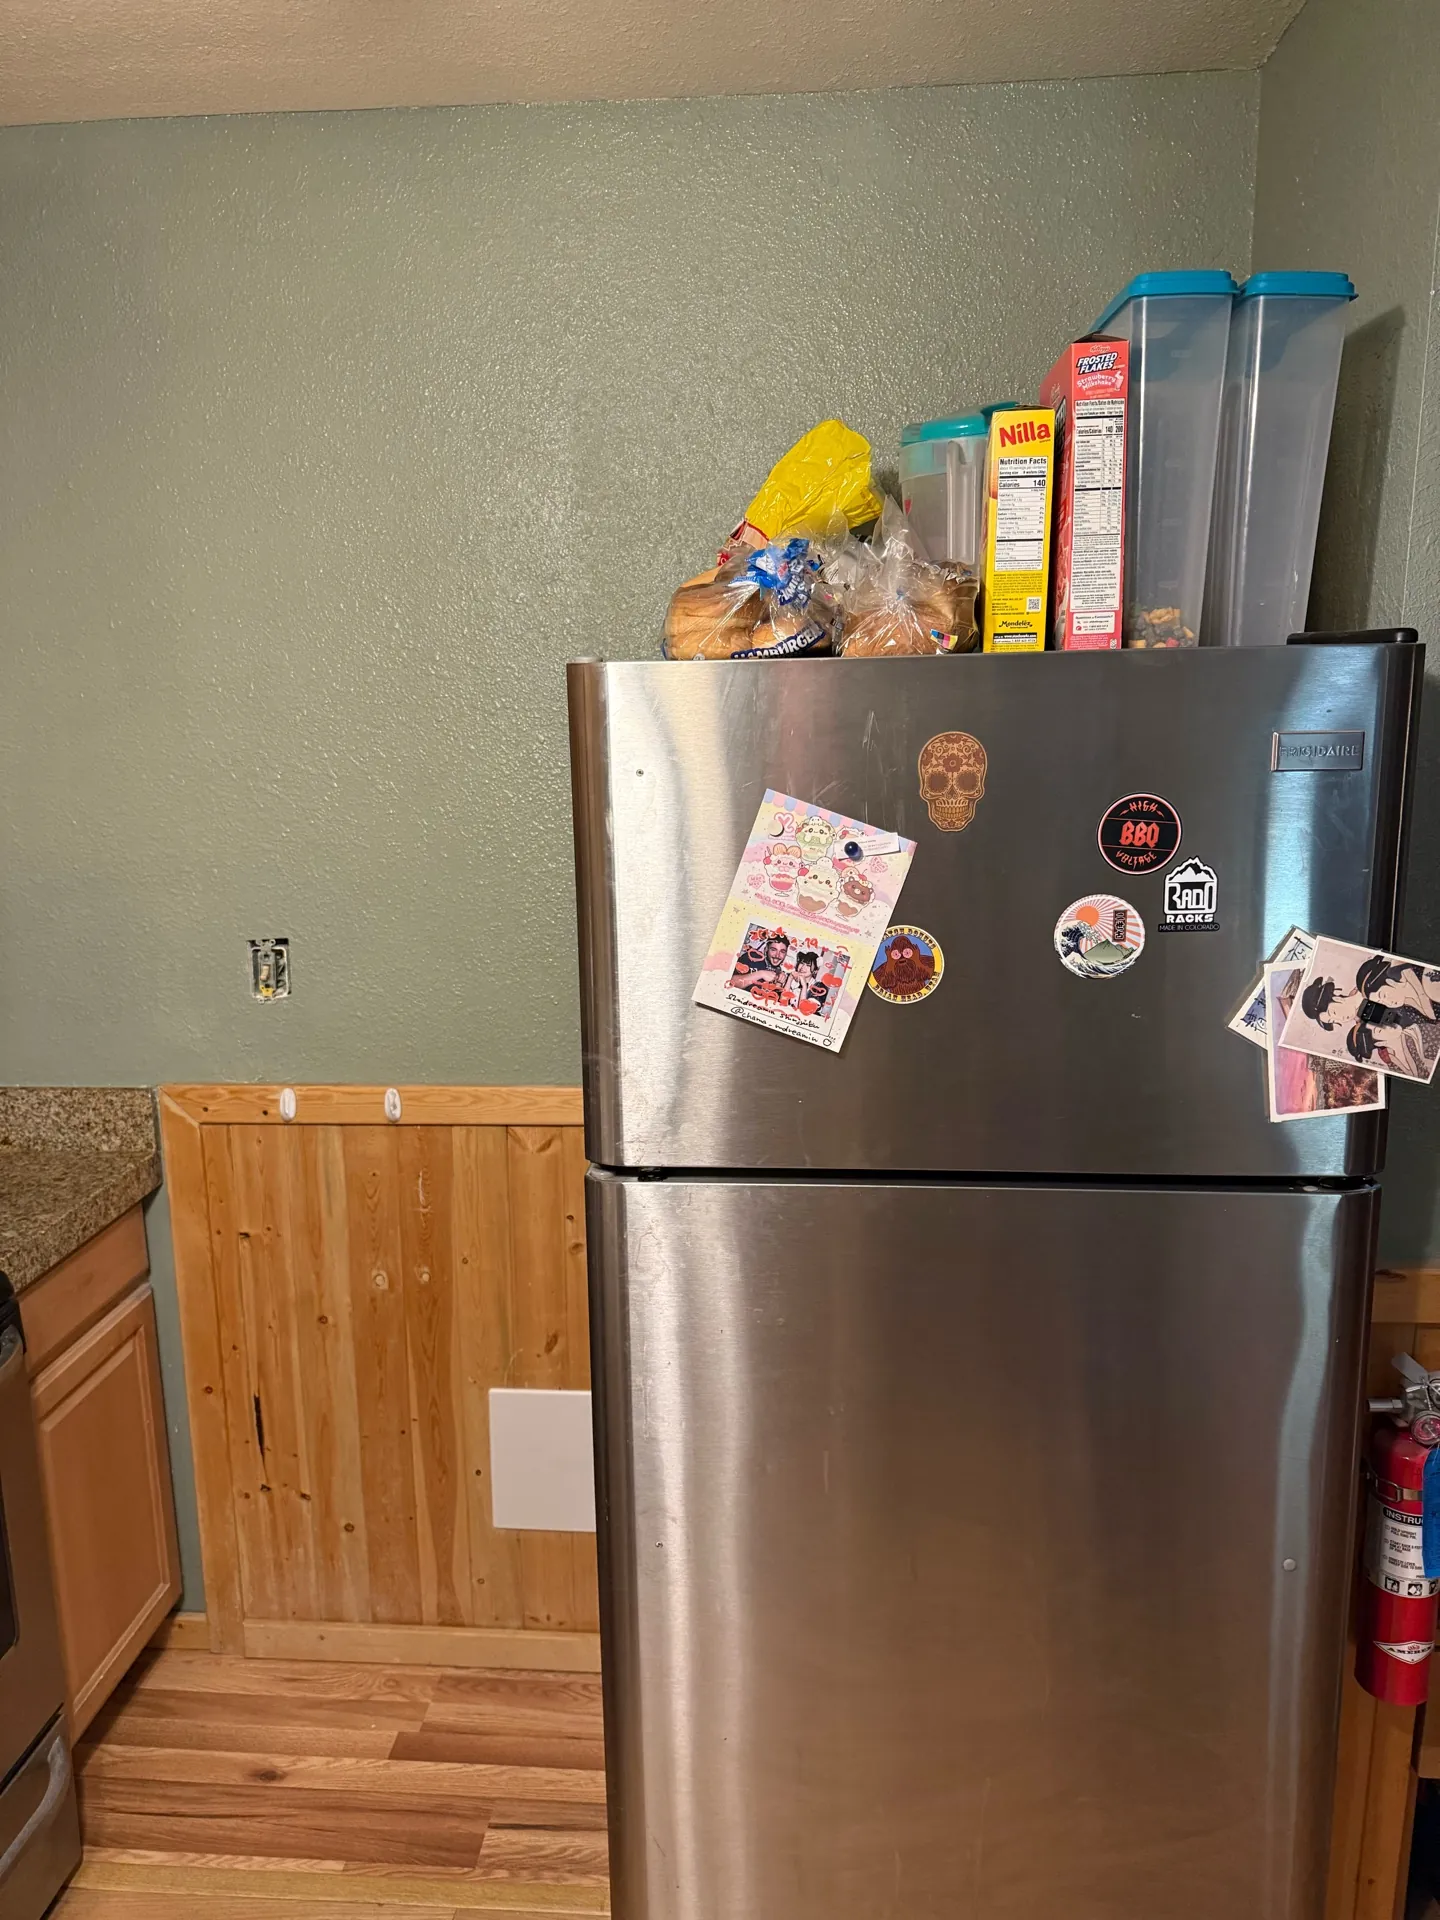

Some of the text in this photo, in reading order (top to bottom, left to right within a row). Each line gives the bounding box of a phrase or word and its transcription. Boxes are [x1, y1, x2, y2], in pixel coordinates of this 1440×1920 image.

[1077, 352, 1118, 367] FROSTED
[1080, 360, 1114, 374] FLAKES
[1077, 374, 1117, 388] Strawberry
[1082, 379, 1112, 391] Milkshake
[999, 421, 1051, 448] Nilla
[1033, 479, 1046, 487] 140
[1279, 745, 1360, 757] FRIGIDAIRE
[1129, 801, 1158, 812] HIGH
[1119, 820, 1160, 849] BBQ
[1115, 850, 1157, 870] VOLTAGE
[1166, 914, 1214, 923] RACKS
[1386, 1509, 1424, 1525] INSTRU
